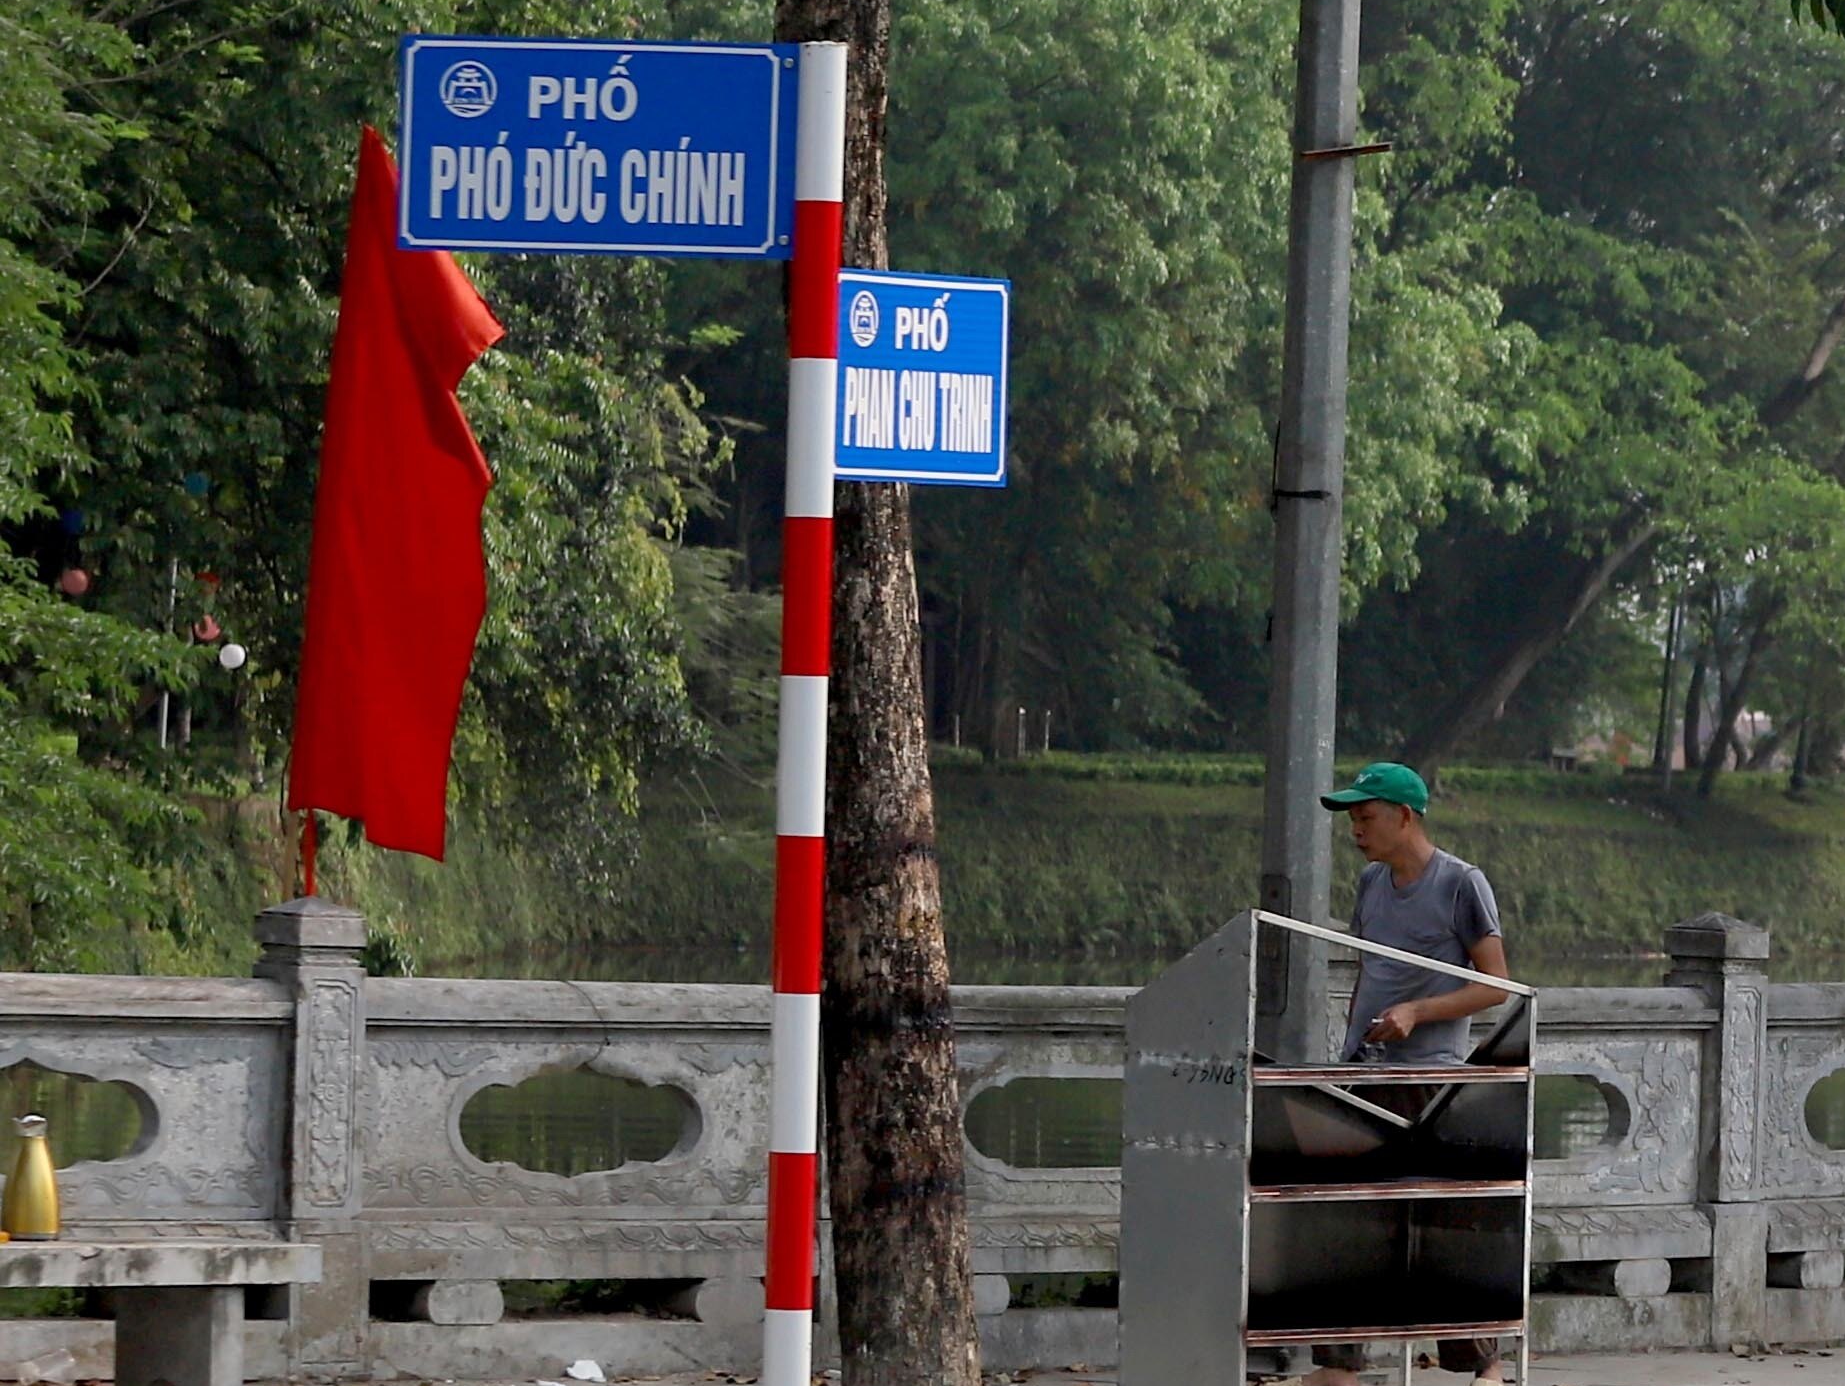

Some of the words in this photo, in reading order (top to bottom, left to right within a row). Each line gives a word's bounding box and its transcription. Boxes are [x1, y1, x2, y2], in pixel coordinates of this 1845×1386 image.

[528, 54, 638, 121] PHỐ
[429, 132, 513, 222] PHÓ
[523, 131, 607, 224] ĐỨC
[620, 137, 746, 227] CHÍNH
[894, 293, 951, 352] PHỐ
[842, 367, 898, 450] PHAN
[899, 370, 936, 451] CHU
[939, 371, 994, 454] TRINH
